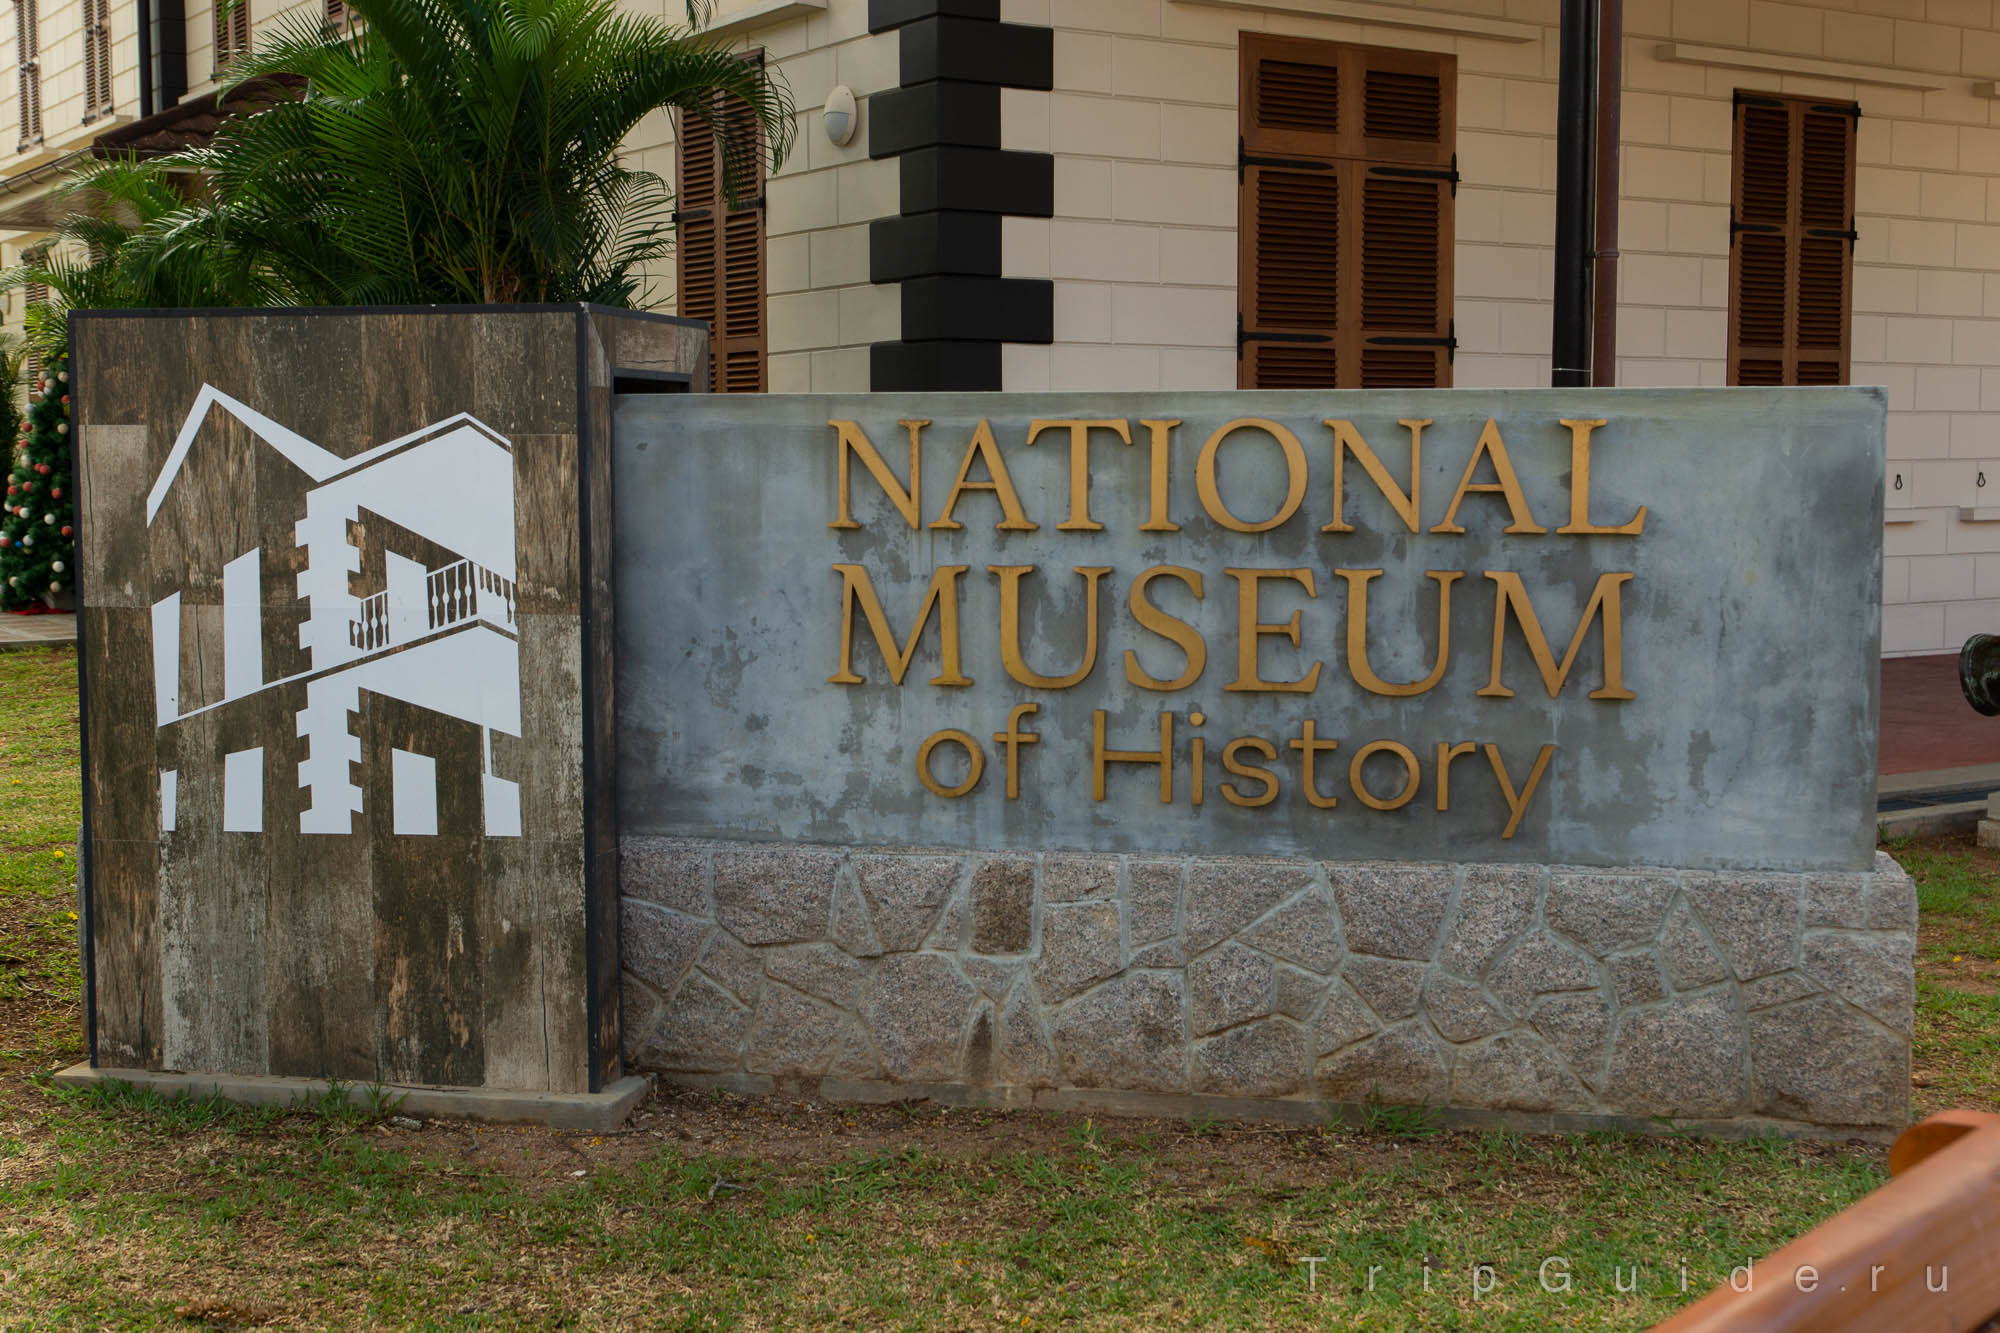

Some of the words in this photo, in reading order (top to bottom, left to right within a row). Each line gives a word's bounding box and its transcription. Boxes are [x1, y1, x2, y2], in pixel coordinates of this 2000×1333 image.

[827, 418, 1648, 535] NATIONAL
[826, 564, 1637, 699] MUSEUM
[915, 703, 1041, 799] of
[1093, 709, 1555, 838] History
